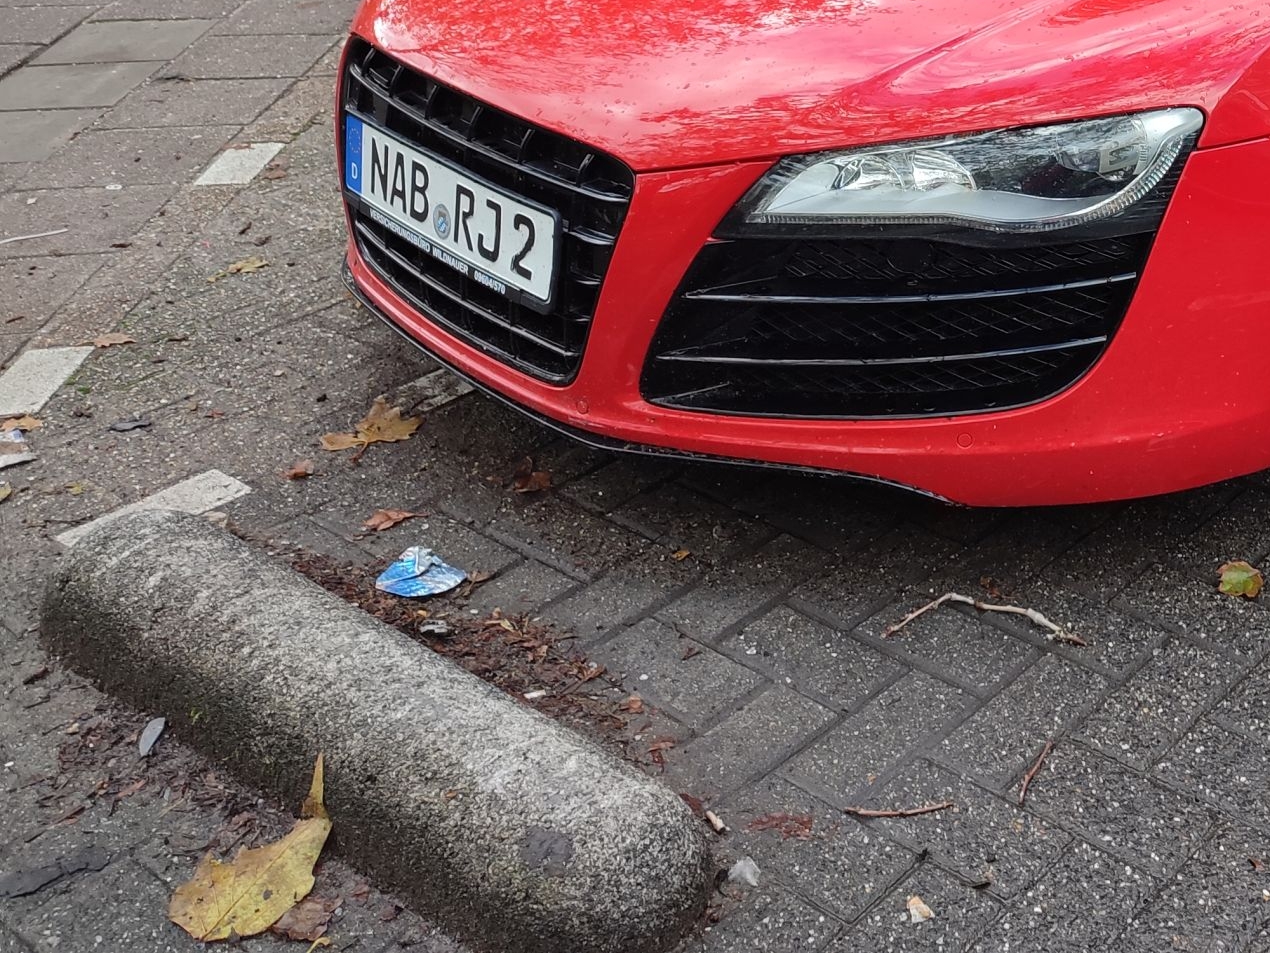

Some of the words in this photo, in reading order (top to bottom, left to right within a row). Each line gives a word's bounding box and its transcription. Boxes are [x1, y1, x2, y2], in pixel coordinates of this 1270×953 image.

[351, 163, 358, 179] D
[370, 136, 430, 223] NAB
[369, 208, 431, 253] VERSICHERUNGSBÜRO
[432, 247, 469, 276] WILDNAUER
[473, 270, 506, 295] 09604/570
